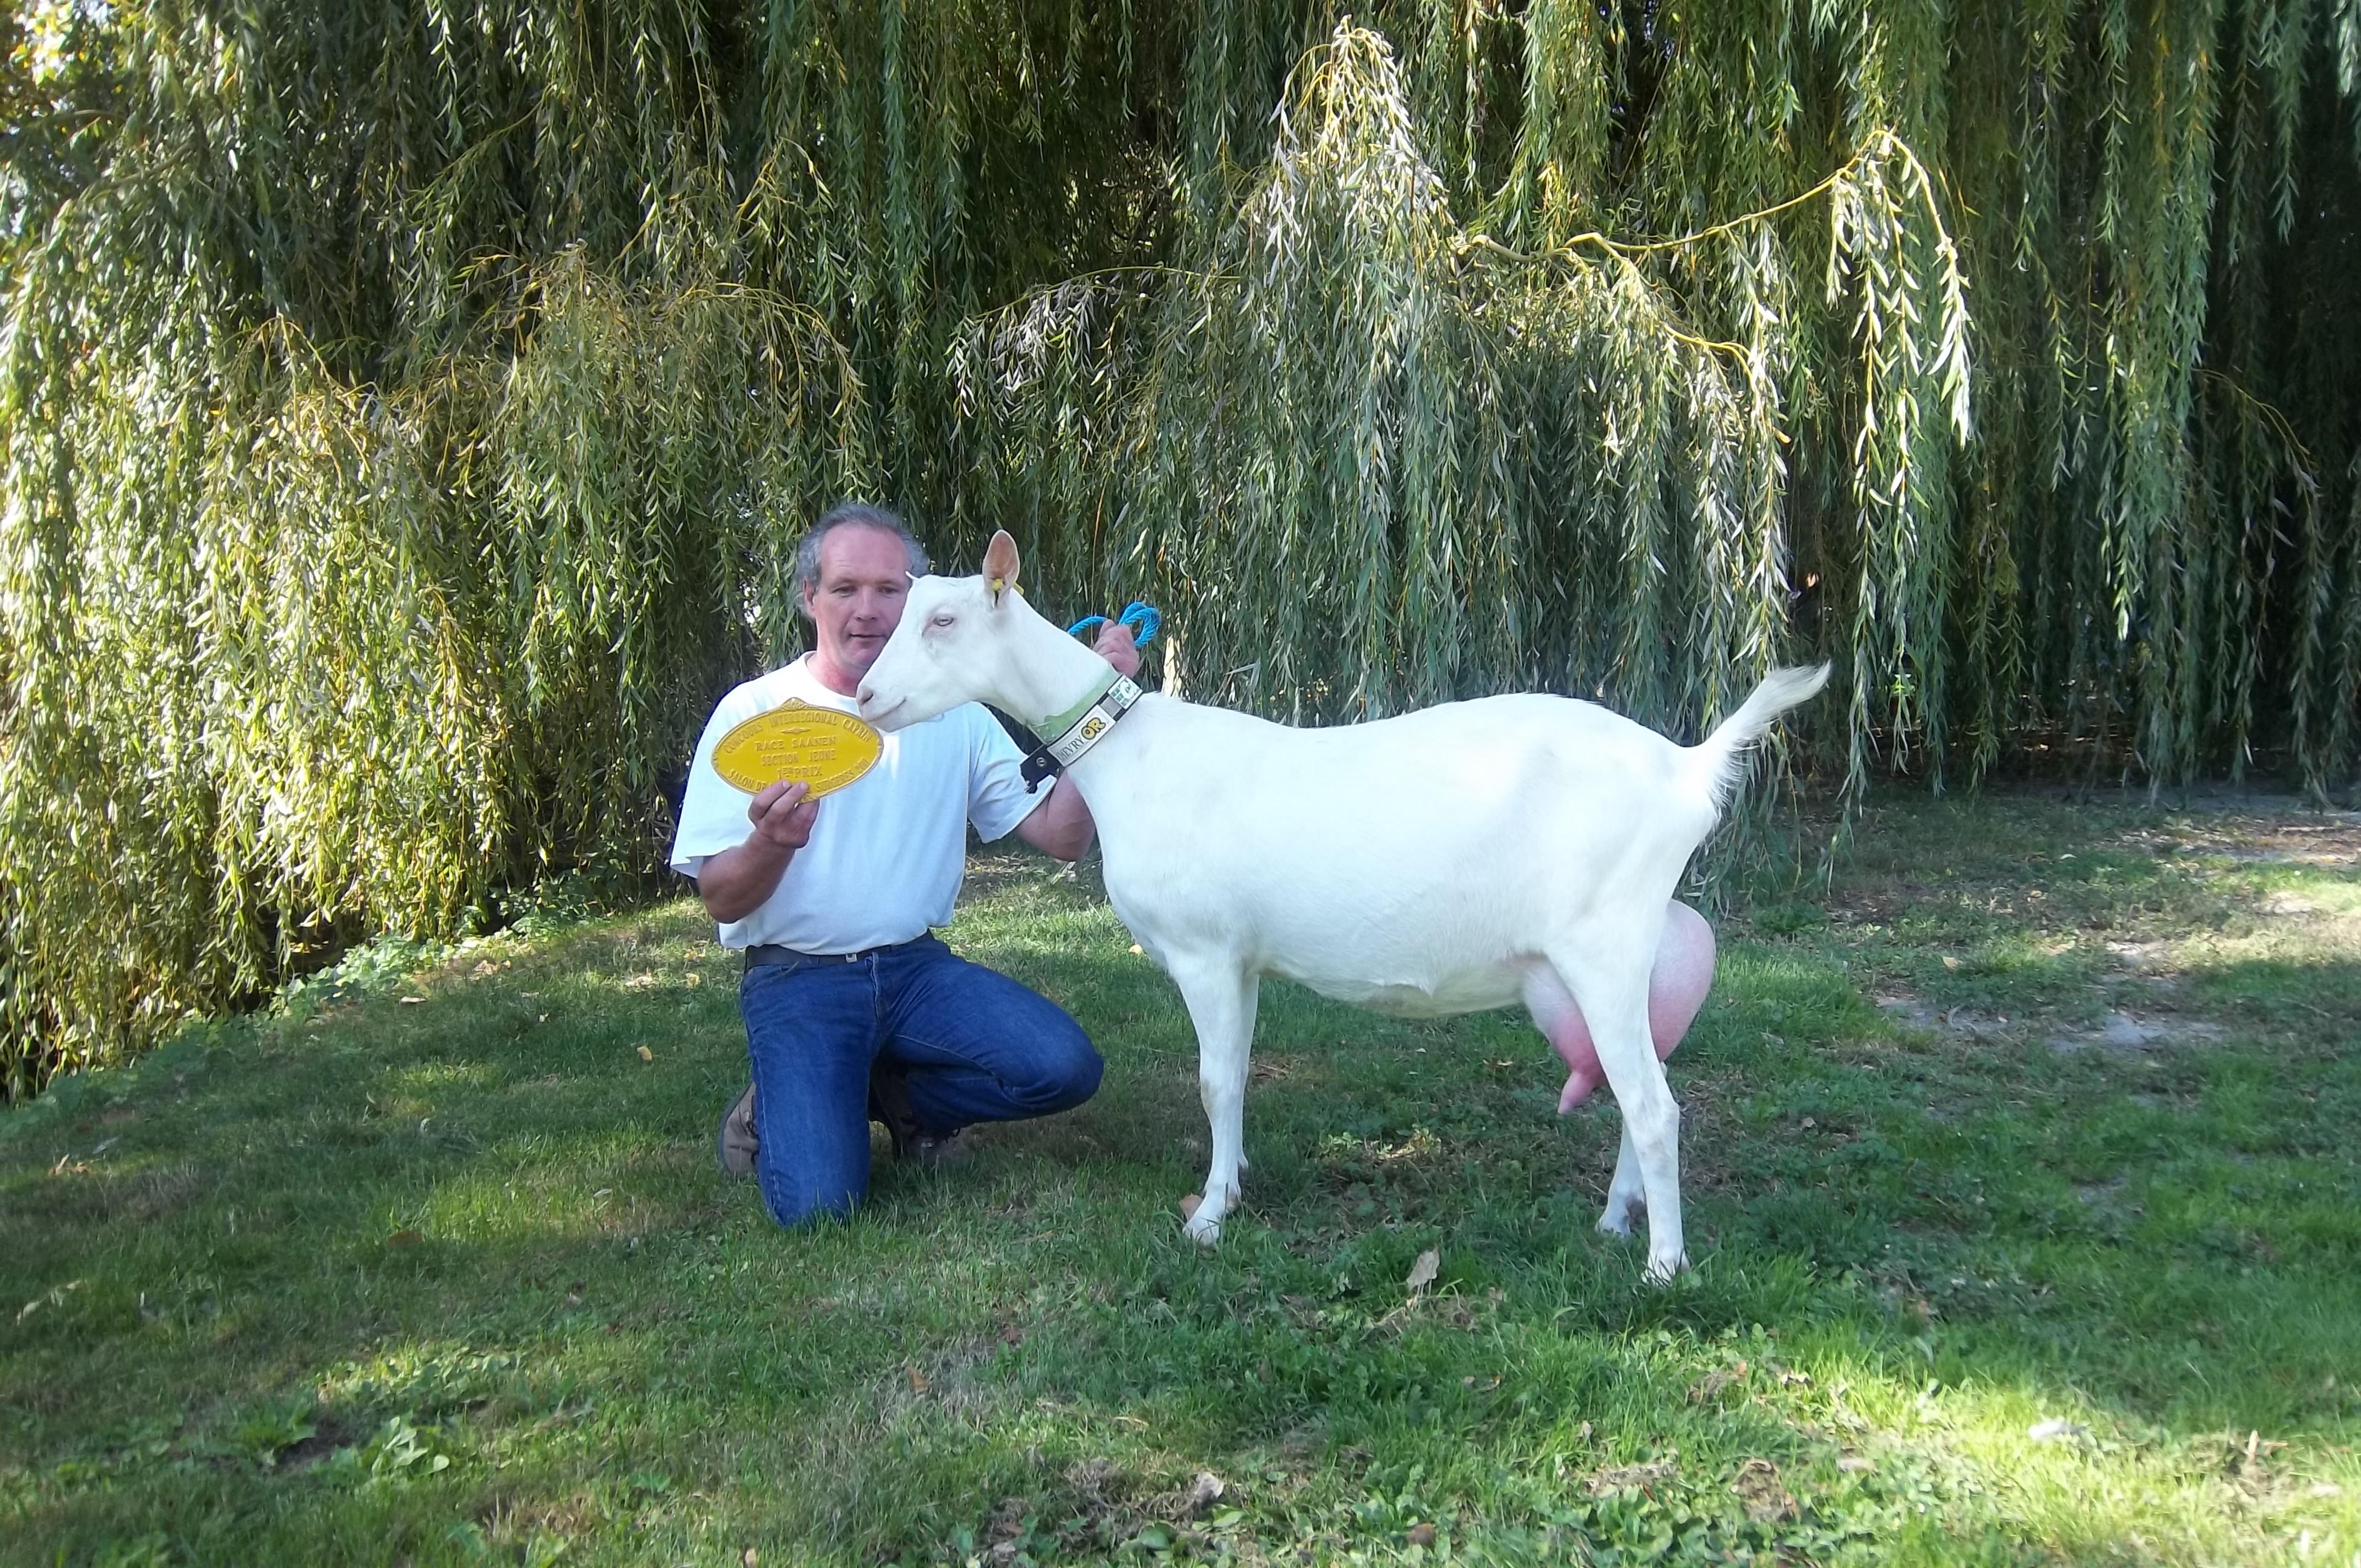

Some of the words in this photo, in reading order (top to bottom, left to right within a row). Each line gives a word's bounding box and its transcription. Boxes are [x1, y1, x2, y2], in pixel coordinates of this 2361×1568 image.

[723, 722, 763, 754] CONCOURS
[769, 711, 837, 727] INTERREGIONAL
[842, 718, 871, 742] CAPRIN
[1081, 717, 1106, 739] OR
[755, 740, 785, 752] RACE
[792, 736, 836, 748] SAANEN
[761, 752, 799, 766] SECTION
[808, 748, 836, 762] JEUNE
[728, 769, 754, 788] SALON
[793, 765, 824, 778] PRIX
